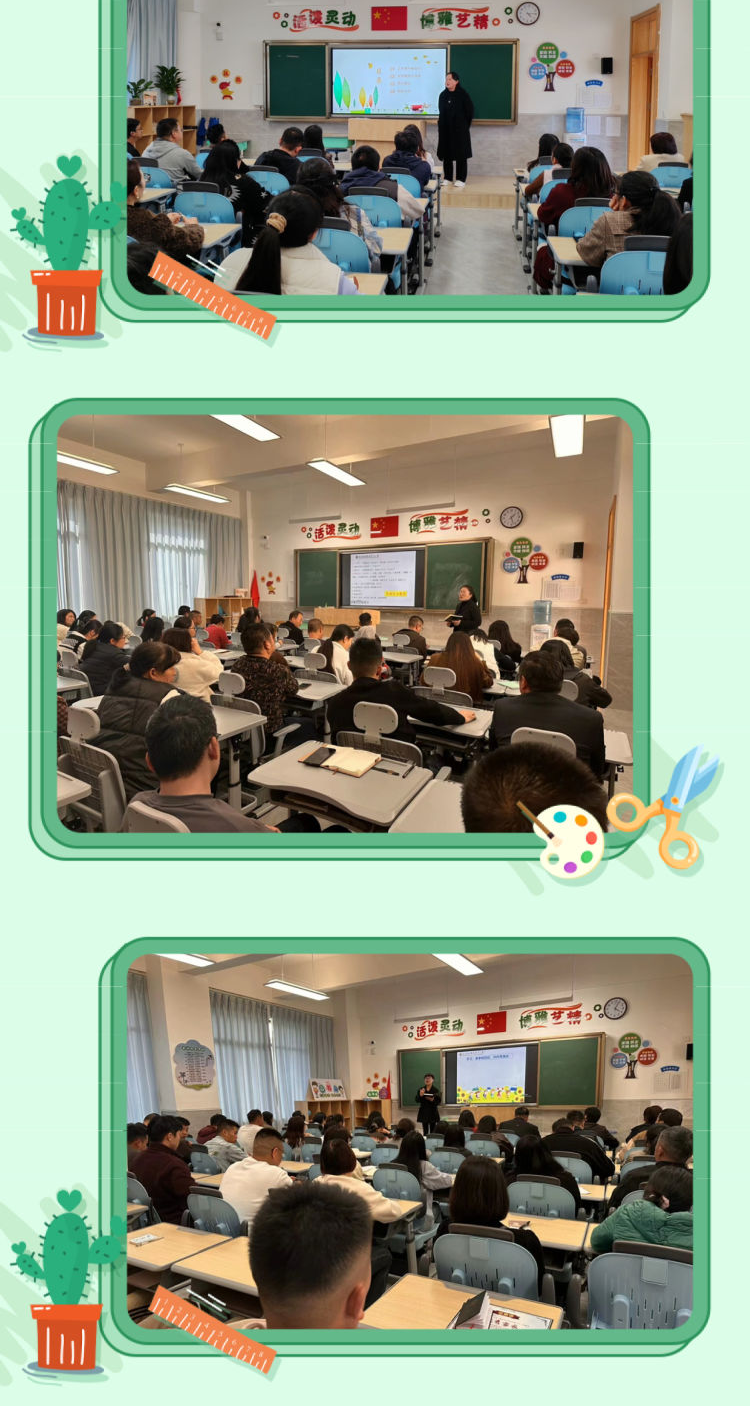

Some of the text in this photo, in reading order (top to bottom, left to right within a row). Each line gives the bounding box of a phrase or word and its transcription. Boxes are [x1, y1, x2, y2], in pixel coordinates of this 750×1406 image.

[314, 522, 360, 540] 活泼灵动
[416, 1019, 464, 1037] 活泼灵动
